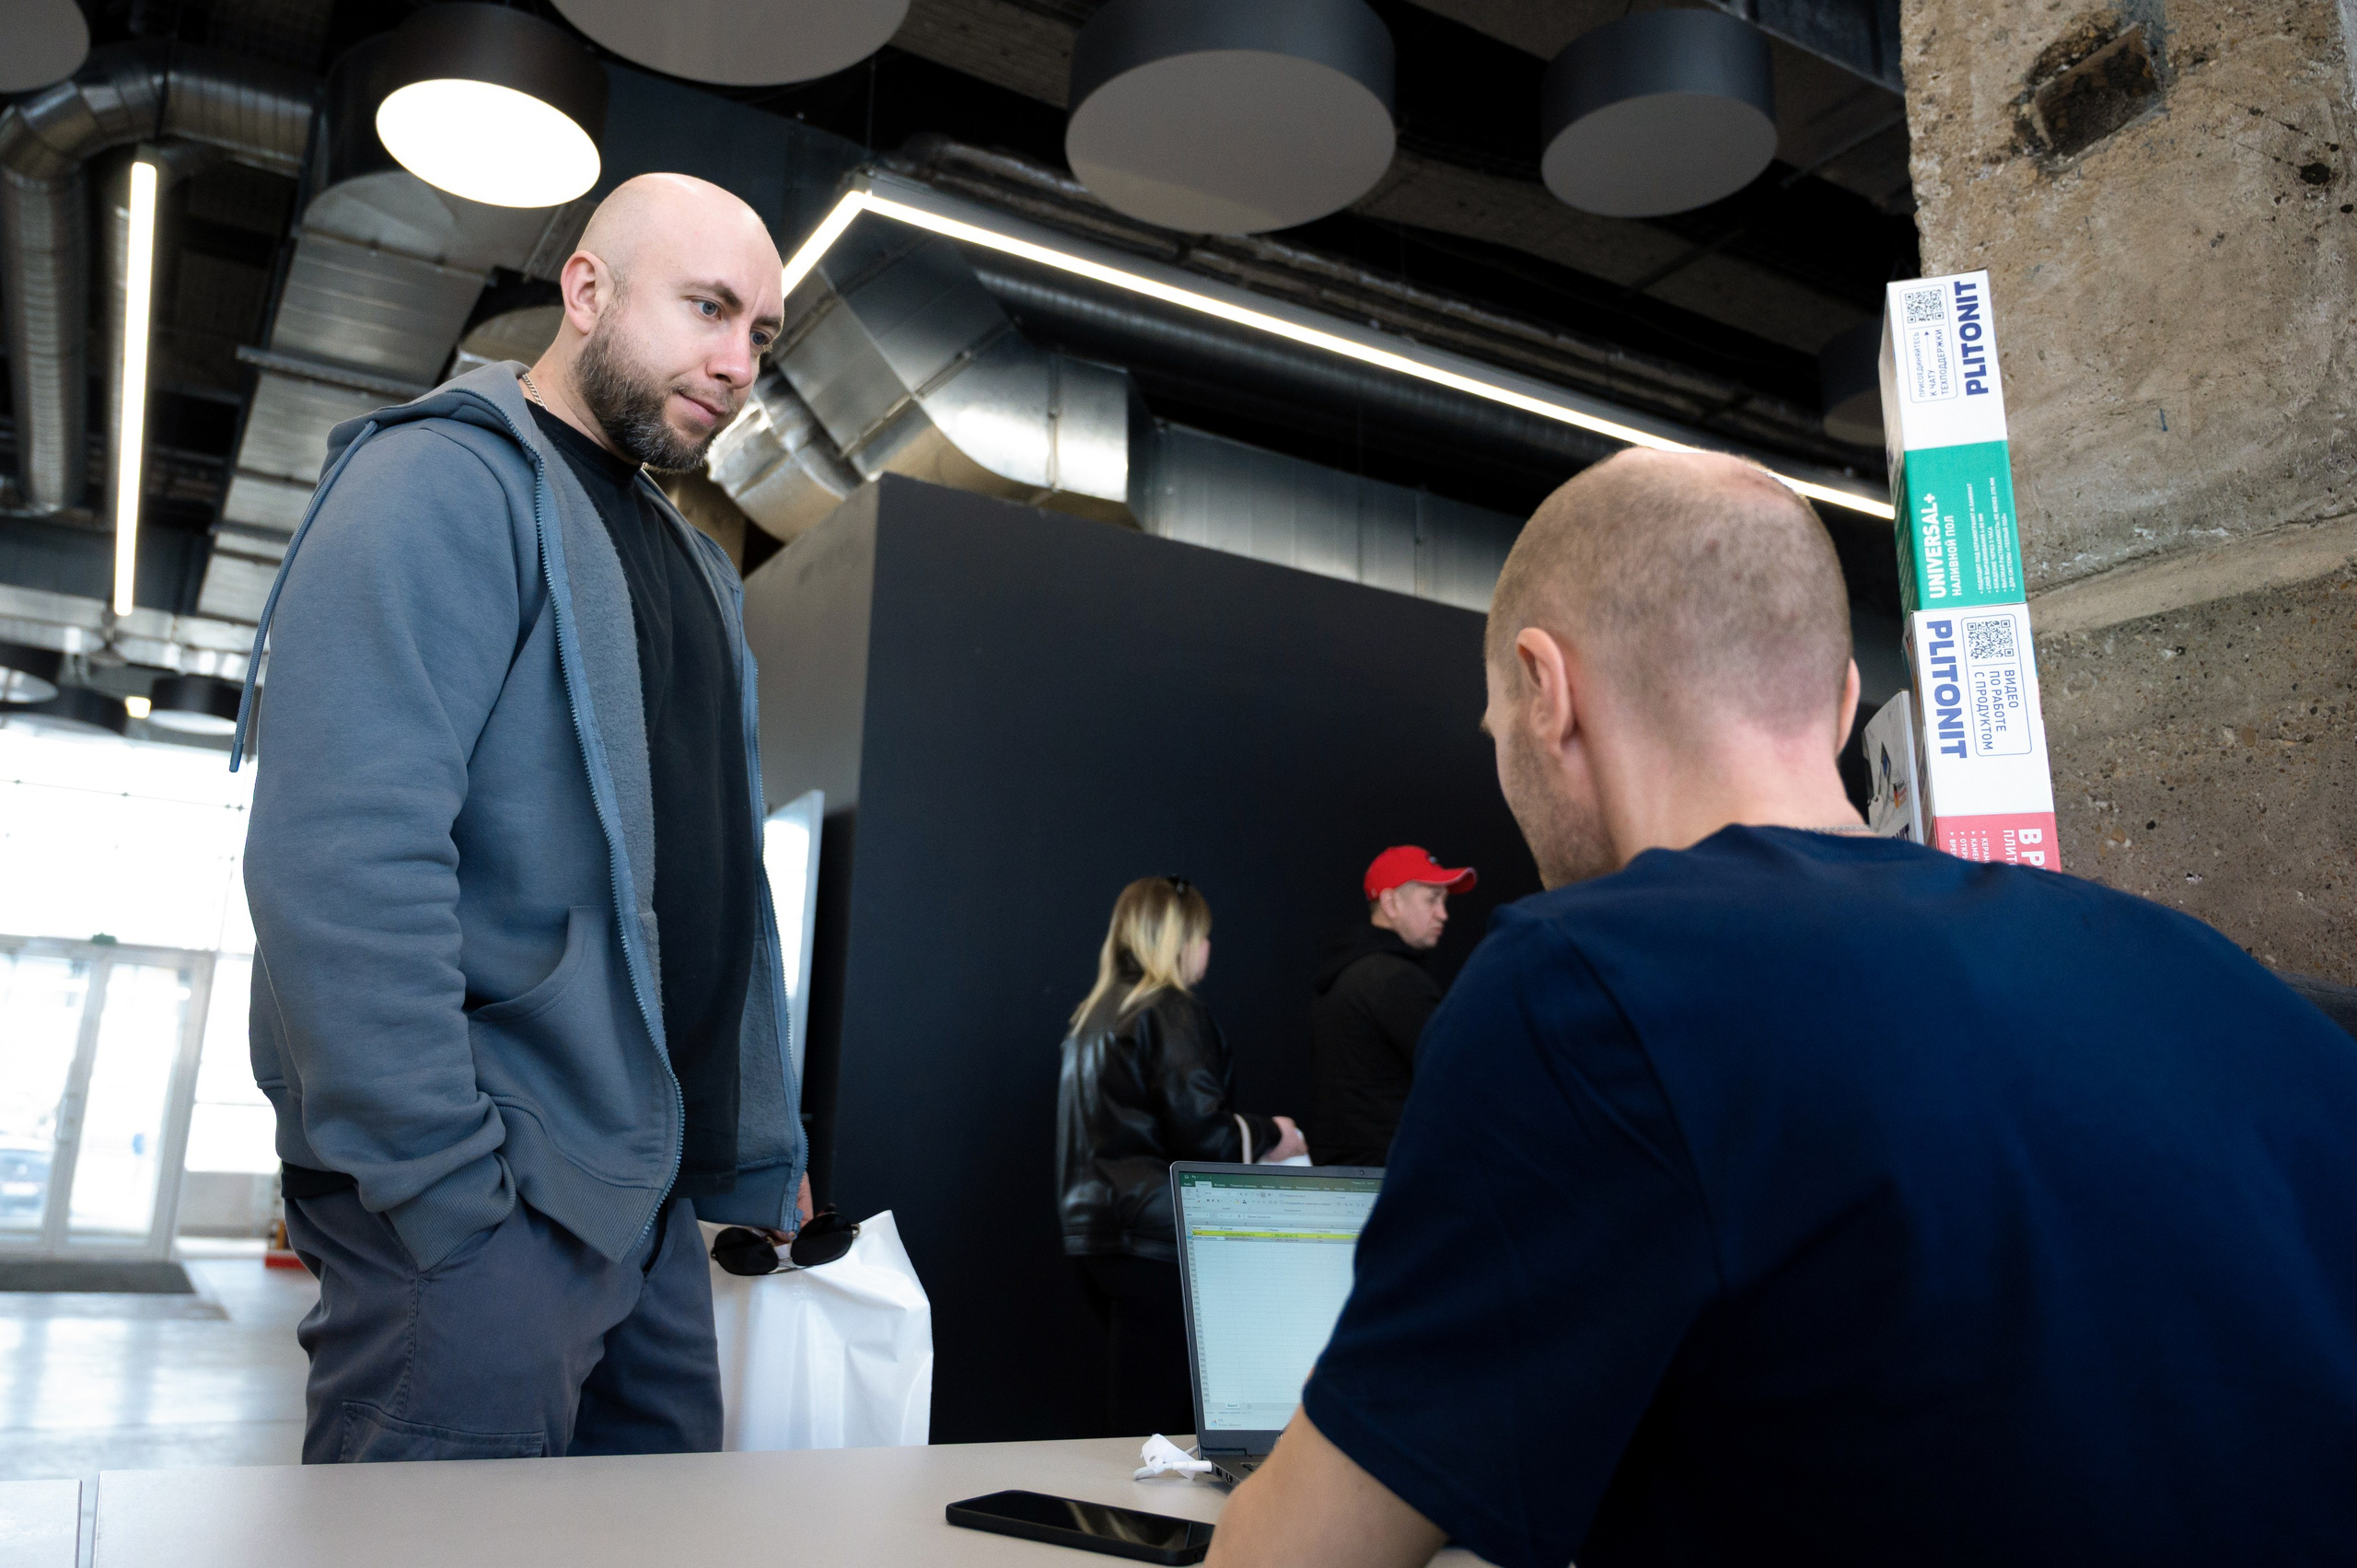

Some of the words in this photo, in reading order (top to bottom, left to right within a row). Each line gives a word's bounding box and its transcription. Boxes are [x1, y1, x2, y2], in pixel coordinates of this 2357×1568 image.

[1914, 331, 1926, 397] ПРИСОЕДИНЯЙТЕСЬ
[1934, 329, 1948, 395] ТЕХПОДДЕРЖКИ
[1954, 281, 1989, 395] PLITONIT
[1928, 369, 1937, 389] ЧАТУ
[1921, 493, 1947, 598] UNIVERSAL+
[1944, 516, 1956, 536] ПОЛ
[1945, 539, 1962, 596] НАЛИВНОЙ
[1926, 620, 1968, 759] PLITONIT
[1989, 670, 2001, 686] ПО
[2003, 669, 2018, 708] ВИДЕО
[1974, 680, 1993, 750] ПРОДУКТОМ
[1991, 689, 2006, 732] РАБОТЕ
[2003, 830, 2018, 865] ПЛИТ
